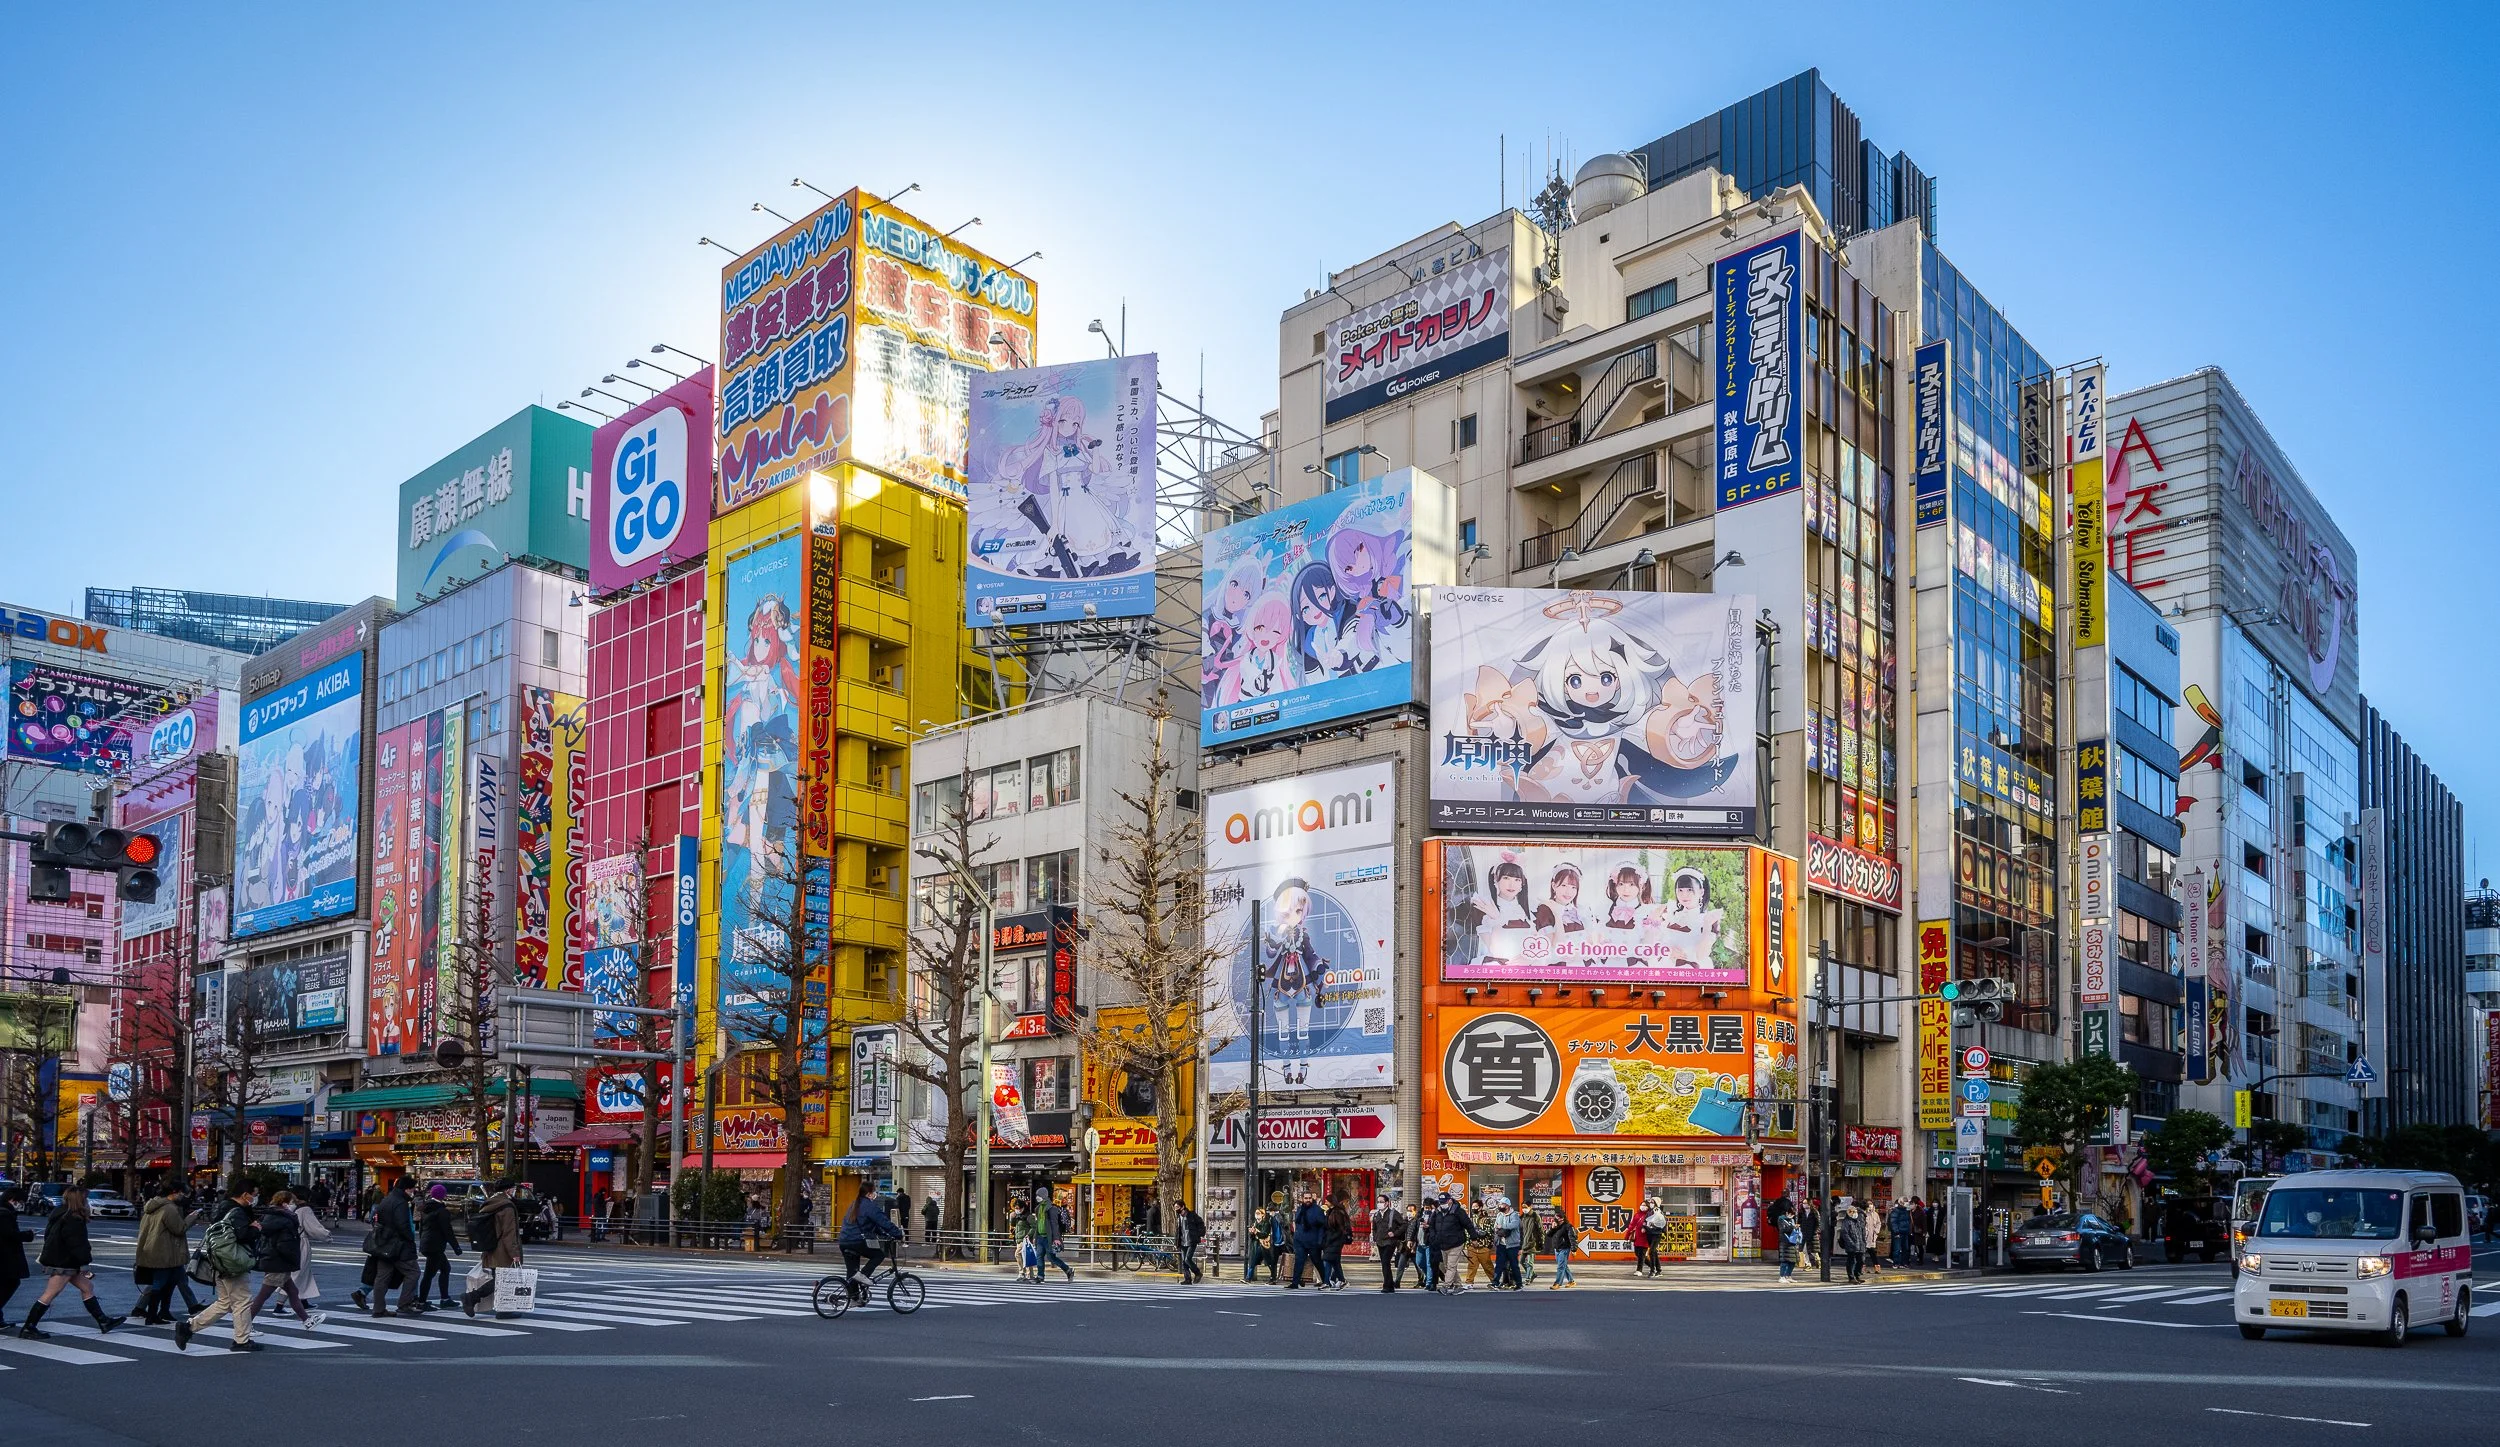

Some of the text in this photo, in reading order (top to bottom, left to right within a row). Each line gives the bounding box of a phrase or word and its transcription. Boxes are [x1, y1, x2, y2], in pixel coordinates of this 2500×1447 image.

[725, 198, 852, 313] MEDIAリサイクル
[862, 208, 1035, 316] MEDIAリサイクル
[724, 247, 851, 371] 激安販売
[1338, 286, 1496, 383] メイドカジノ
[1340, 299, 1419, 348] Pokerの聖地
[721, 313, 847, 437] 高額買取
[2078, 375, 2098, 453] スーパービル
[721, 392, 850, 505] Mulan
[1723, 411, 1738, 480] 秋葉原店
[813, 550, 834, 564] ブルーレイ
[814, 537, 834, 552] DVD
[984, 541, 1000, 551] ミカ
[812, 562, 834, 577] ゲーム
[816, 575, 830, 587] CD
[2077, 501, 2095, 639] Yellow Submarine
[812, 586, 833, 600] アイドル
[812, 599, 833, 613] アニメ
[1439, 593, 1504, 603] HOYOVERSE
[812, 611, 832, 624] コミック
[813, 623, 832, 635] ホビー
[812, 635, 832, 648] フィギュア
[1727, 608, 1742, 693] 冒険に満ちた
[249, 667, 282, 694] Sofmap
[260, 668, 350, 725] ソフマップ AKIBA
[1234, 708, 1254, 717] ブルアカ
[1709, 658, 1726, 794] ブランニューワールドへ
[380, 742, 397, 769] 4F
[1441, 730, 1532, 785] 原神
[379, 768, 406, 786] カードゲーム
[1449, 773, 1504, 782] Genshin
[1962, 746, 2009, 797] 秋葉館
[479, 758, 497, 824] AKKY
[2027, 776, 2041, 795] Mac
[2079, 746, 2105, 831] 秋葉館
[1225, 789, 1373, 845] amiami
[1532, 808, 1569, 820] Windows
[1667, 812, 1685, 821] 原神
[377, 831, 394, 859] 3F
[1335, 864, 1388, 880] arctech
[1809, 841, 1899, 904] メイドカジノ
[2086, 844, 2101, 915] amiami
[2366, 816, 2382, 948] AKIBAカルチャーズZONE
[679, 875, 695, 926] GiGO
[805, 884, 816, 894] 5F
[815, 885, 829, 897] 中古
[815, 913, 829, 924] 中古
[374, 930, 391, 957] 2F
[2190, 902, 2200, 969] at-home cafe
[1634, 943, 1671, 958] cafe
[1921, 928, 1948, 994] 免税
[2087, 928, 2103, 990] あみあみ
[373, 959, 392, 972] プライズ
[373, 972, 400, 985] レトロゲーム
[735, 967, 767, 977] Genshin
[1324, 968, 1380, 985] amiami
[329, 977, 346, 986] RELEASE
[1054, 948, 1071, 1018] 吉野家
[1568, 1015, 1745, 1055] チケット 大黒屋
[2192, 1000, 2201, 1057] GALLERIA
[1283, 1046, 1349, 1056] アクションフィギュア
[1921, 1000, 1937, 1093] 면세점
[1936, 1001, 1949, 1093] TAX FREE
[1969, 1053, 1984, 1064] 40
[2490, 1024, 2500, 1096] ダイナミックオーディオ
[1457, 1031, 1551, 1115] 質
[1969, 1085, 1980, 1100] P
[410, 1111, 467, 1129] Tax-free Shop
[545, 1114, 569, 1123] Japan.
[803, 1103, 825, 1113] AKIBA
[542, 1123, 570, 1131] Tax-free
[1257, 1119, 1319, 1139] COMIC
[592, 1156, 610, 1164] GiGO
[1496, 1152, 1513, 1162] 時計
[1590, 1170, 1622, 1199] 質
[1578, 1205, 1633, 1234] 買取
